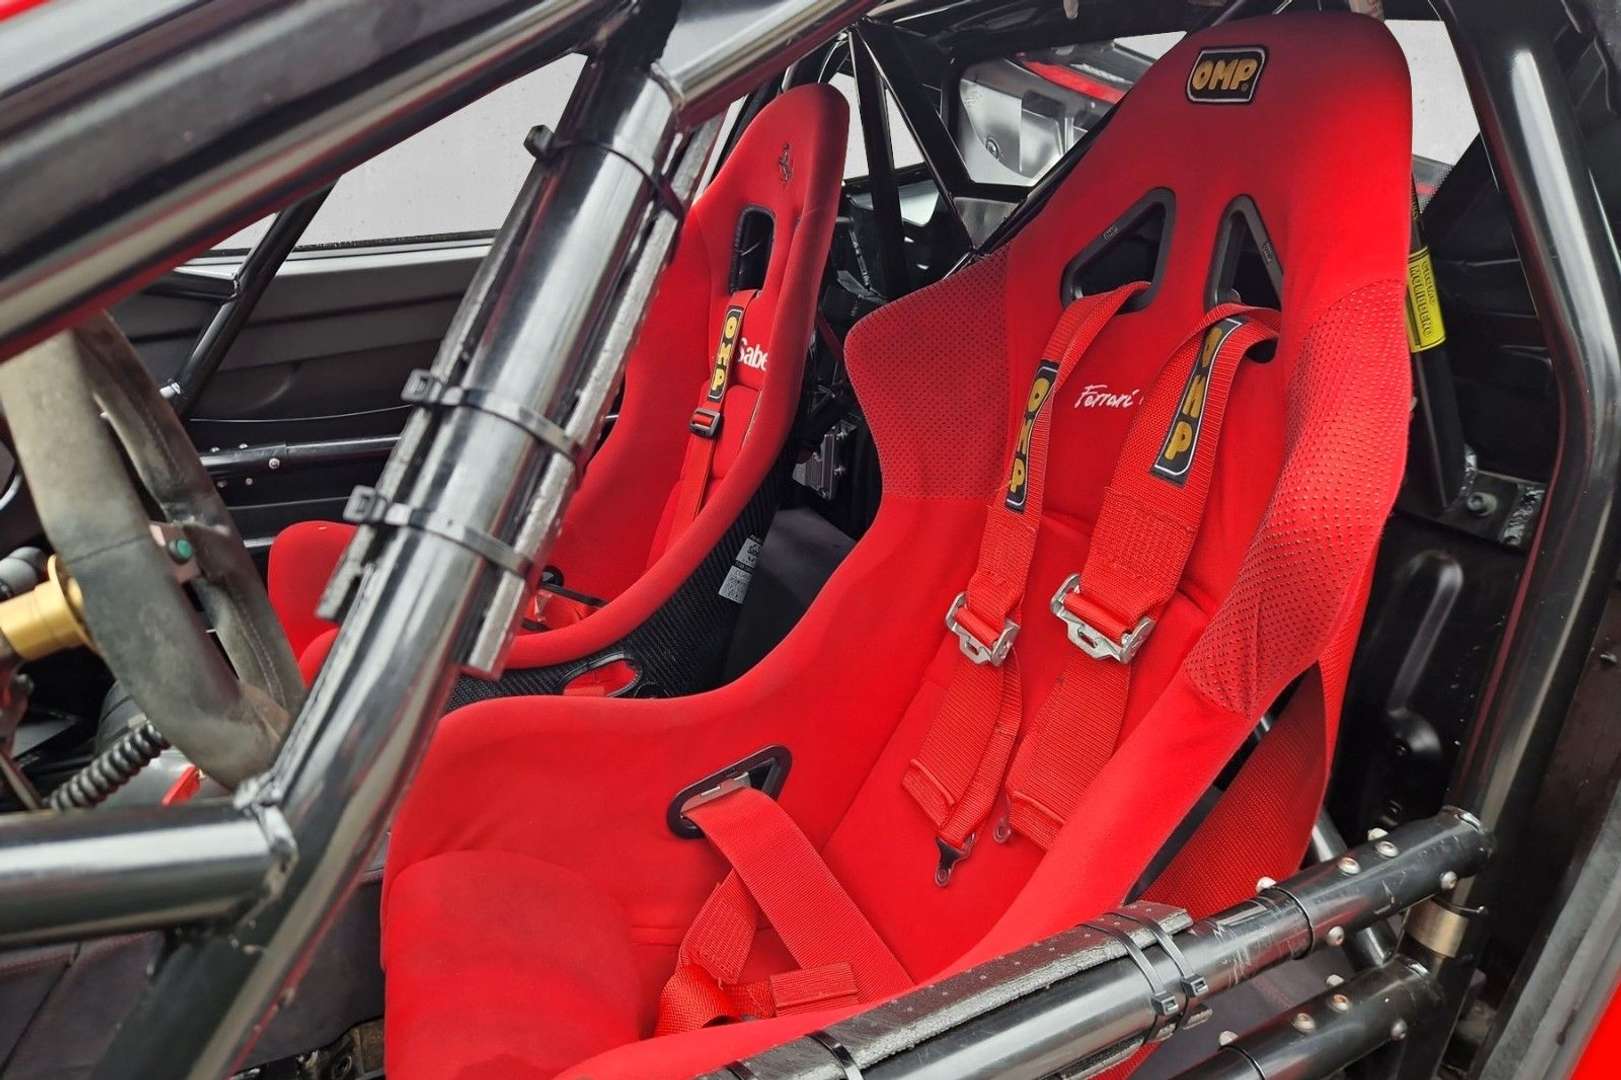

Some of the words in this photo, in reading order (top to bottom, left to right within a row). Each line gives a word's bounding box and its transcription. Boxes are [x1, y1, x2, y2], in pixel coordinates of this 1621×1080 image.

[1192, 59, 1258, 90] OMP
[711, 316, 738, 391] OMP
[1074, 384, 1140, 409] Ferrari
[1164, 327, 1223, 460] OMP
[1010, 378, 1050, 493] OMP
